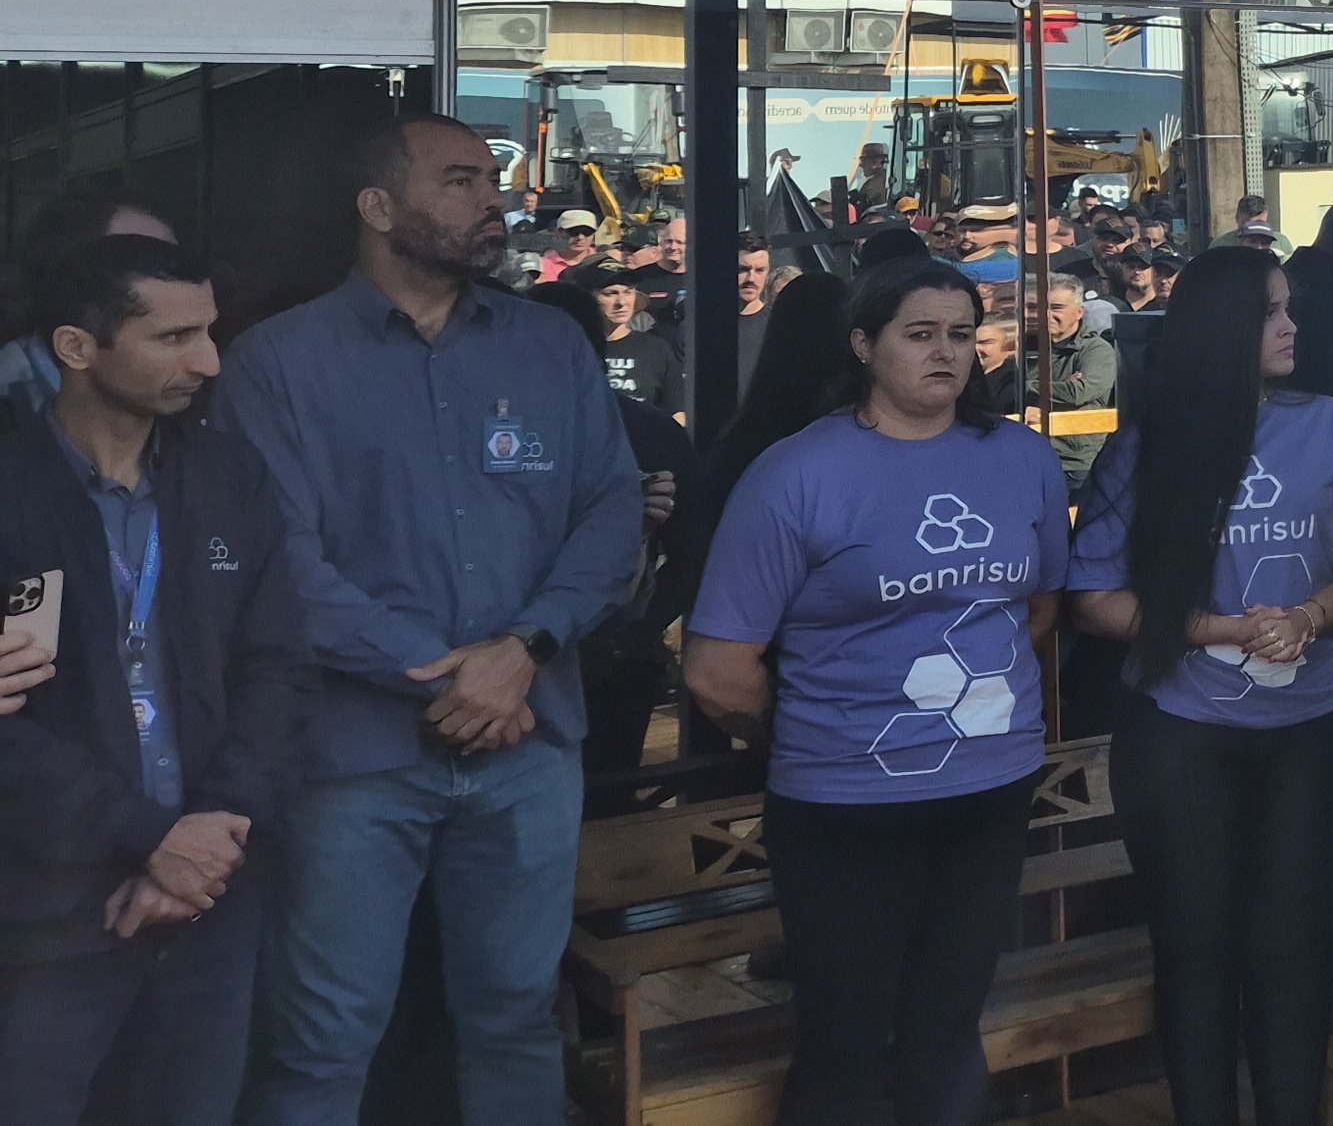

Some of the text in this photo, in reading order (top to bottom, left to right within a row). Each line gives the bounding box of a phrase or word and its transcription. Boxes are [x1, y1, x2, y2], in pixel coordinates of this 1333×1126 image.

[522, 460, 554, 471] nrisul
[1219, 513, 1315, 545] nrisul
[211, 561, 239, 571] nrisul
[878, 556, 1029, 602] banrisul
